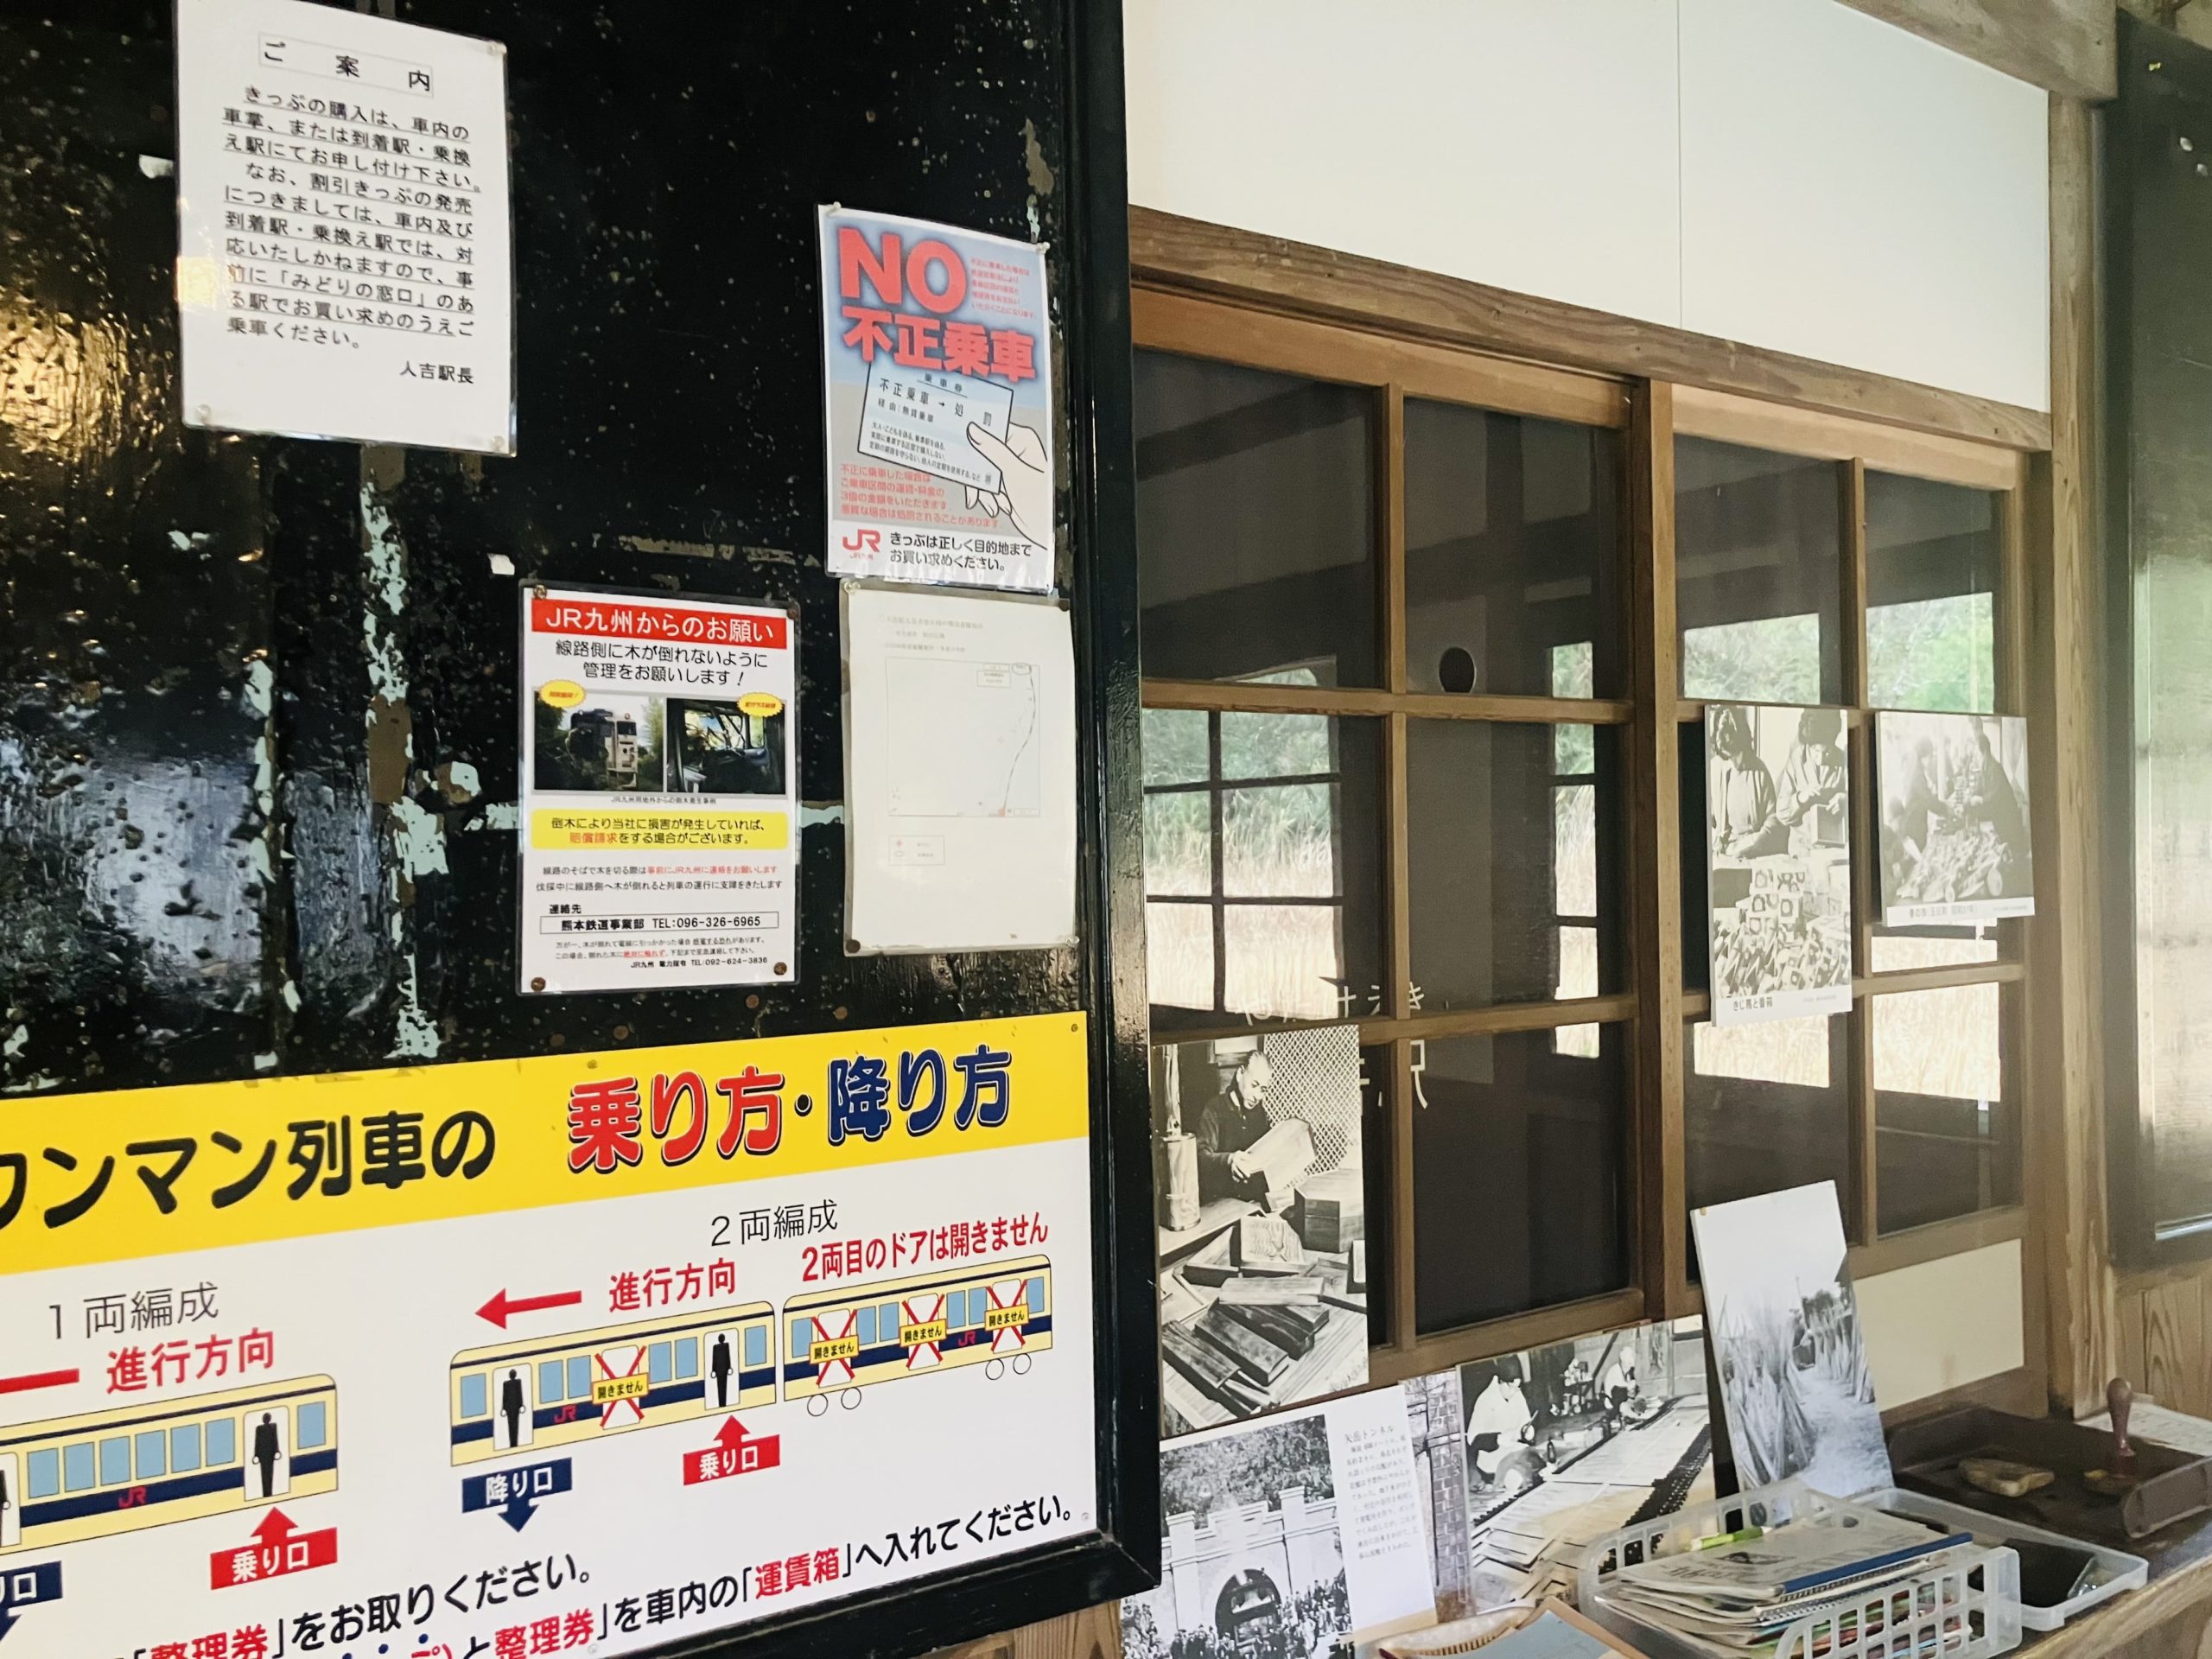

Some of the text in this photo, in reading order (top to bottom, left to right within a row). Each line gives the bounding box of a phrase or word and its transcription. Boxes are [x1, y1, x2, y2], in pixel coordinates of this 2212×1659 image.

[245, 86, 470, 140] きっぷの購入は、車内の
[223, 108, 472, 167] 車掌、または到着駅・乗換
[225, 132, 480, 193] え駅にてお申し付け下さい。
[246, 162, 473, 214] なお、割引きっぷの発売
[226, 186, 474, 238] につきましては、車内及び
[226, 212, 474, 264] 到着駅・乗換え駅では、対
[226, 238, 474, 289] 応いたしかねますので、事
[837, 226, 968, 314] NO
[227, 264, 474, 313] 前に「みどりの窓口」のあ
[229, 290, 474, 337] る駅でお買い求めのうえご
[227, 316, 360, 348] 乗車ください。
[842, 305, 1036, 384] 不正乗車
[400, 361, 474, 385] 人吉駅長
[842, 529, 881, 553] JR
[890, 531, 1033, 557] きっぷは正しく目的地まで
[890, 548, 1006, 572] お買い求めください。
[545, 607, 774, 643] JR九州からのお願い
[556, 639, 768, 670] 線路側に木が倒れないように
[583, 662, 747, 687] 管理をお願いします!
[551, 817, 766, 831] 倒木により当社に損害が発生していれば、
[569, 831, 750, 846] 賠償請求をする場合がございます。
[549, 903, 582, 914] 連絡先
[561, 916, 761, 931] 熊本鉄道事業部 TEL:096-326-6965
[568, 1043, 1012, 1174] 乗り方・降り方
[711, 1199, 839, 1248] 2両編成
[802, 1211, 1048, 1283] 2両目のドアは開きません
[609, 1258, 736, 1313] 進行方向
[49, 1281, 219, 1341] 1両編成
[988, 1311, 1026, 1326] 開きません
[813, 1343, 855, 1360] 開きません
[904, 1325, 943, 1343] 開きません
[957, 1331, 976, 1346] JR
[106, 1327, 275, 1394] 進行方向
[597, 1379, 644, 1401] 開きません
[554, 1403, 577, 1424] JR
[699, 1445, 760, 1480] 乗り口
[118, 1485, 148, 1509] JR
[486, 1466, 554, 1505] 降り口
[232, 1541, 310, 1583] 乗り口
